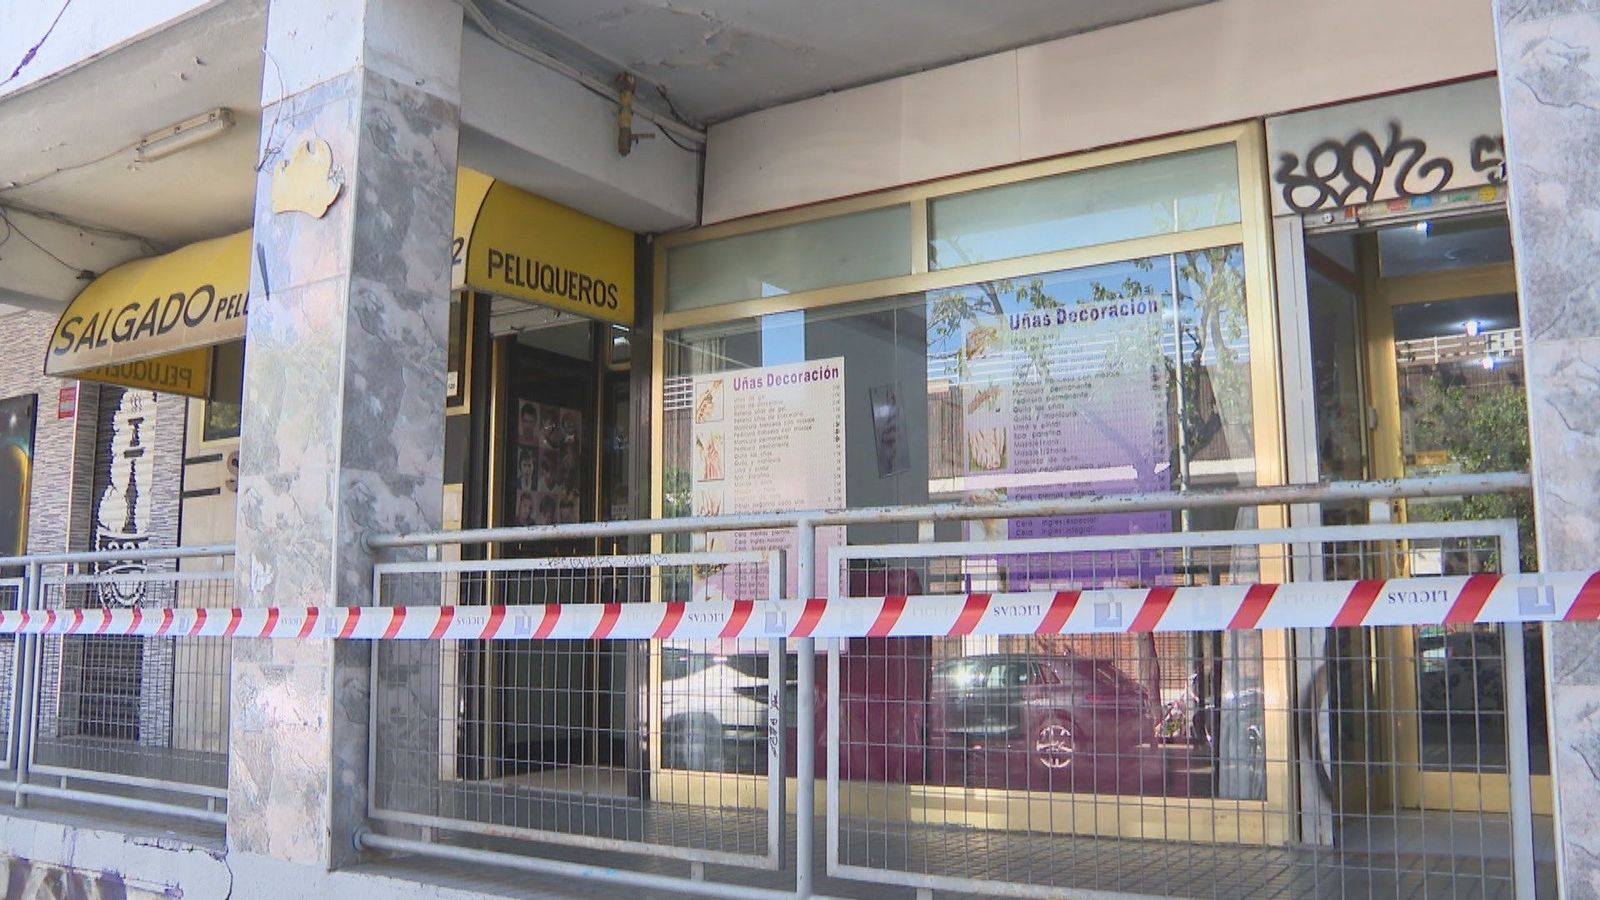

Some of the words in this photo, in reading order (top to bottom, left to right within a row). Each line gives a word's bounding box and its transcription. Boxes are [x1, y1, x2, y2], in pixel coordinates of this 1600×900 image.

[488, 247, 618, 310] PELUQUEROS
[53, 284, 216, 356] SALGADO
[1010, 313, 1052, 331] Uñas
[733, 376, 763, 391] Uñas
[766, 364, 839, 387] Decoración
[1388, 590, 1448, 604] LICUAS
[993, 604, 1041, 616] LICUAS
